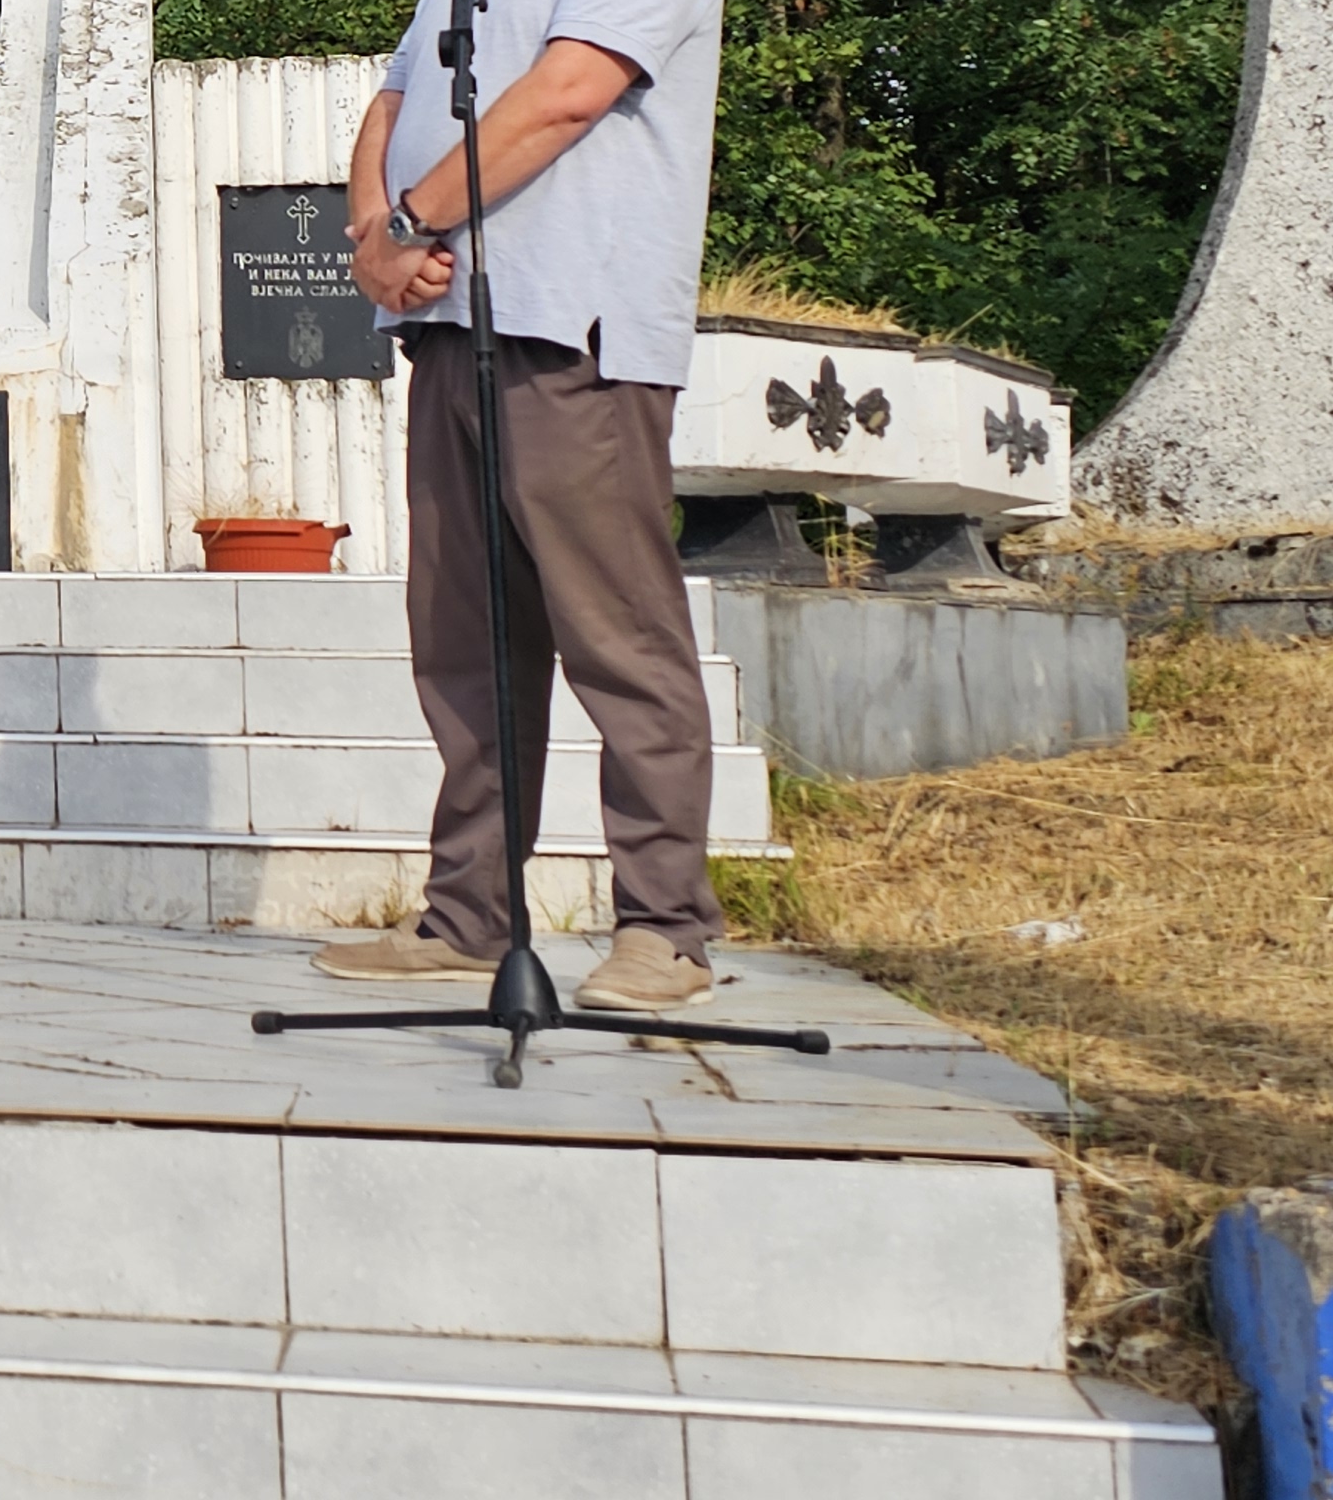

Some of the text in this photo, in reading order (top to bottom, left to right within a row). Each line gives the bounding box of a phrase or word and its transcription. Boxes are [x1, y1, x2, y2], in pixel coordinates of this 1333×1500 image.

[233, 253, 315, 269] ПОЧИВАЈТЕ
[322, 253, 331, 263] У
[249, 269, 258, 280] И
[265, 269, 301, 280] НЕКА
[307, 269, 337, 280] ВАМ
[251, 285, 358, 296] ВЈЕЧНА СЛАВА
